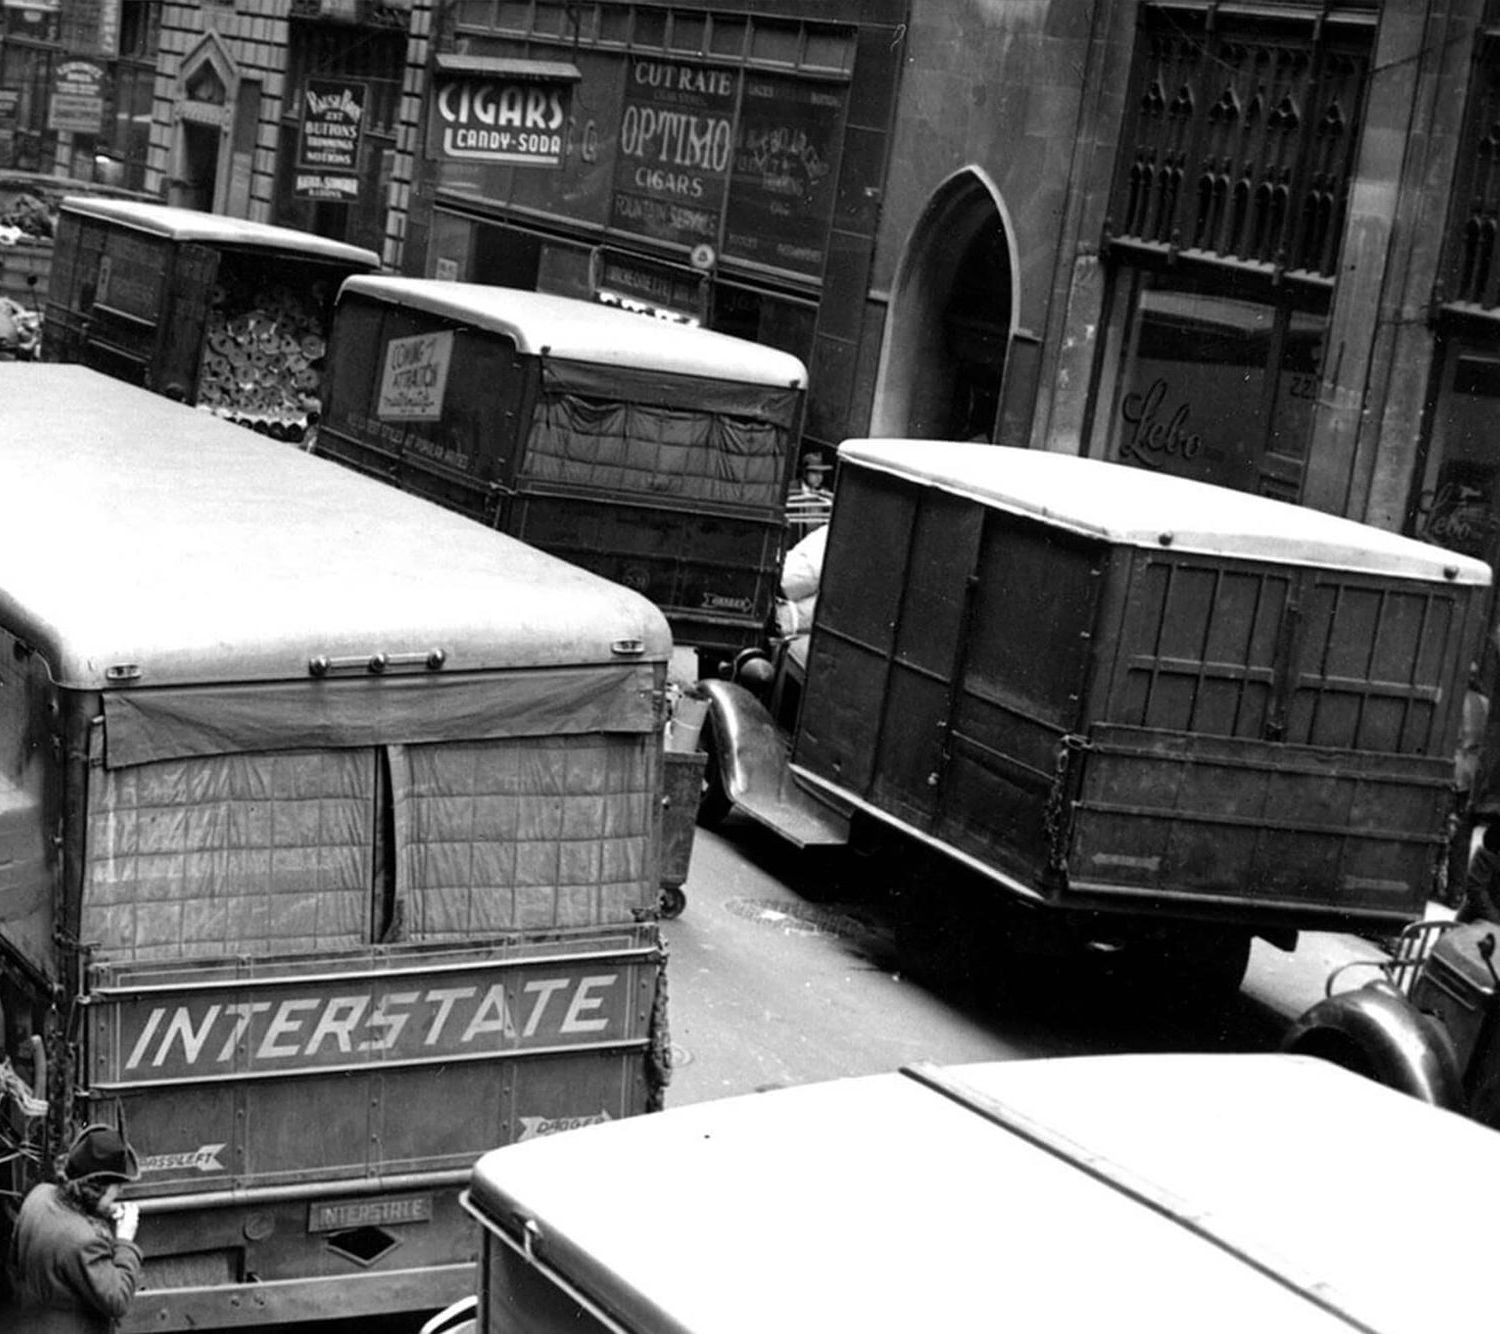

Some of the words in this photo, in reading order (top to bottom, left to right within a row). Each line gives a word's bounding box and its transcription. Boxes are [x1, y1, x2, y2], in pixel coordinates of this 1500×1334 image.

[635, 61, 677, 88] CUT
[679, 66, 731, 95] RATE
[439, 81, 563, 130] CIGARS
[621, 105, 730, 171] OPTIMO
[635, 166, 703, 197] CIGARS
[1119, 378, 1200, 468] Lebo
[124, 974, 618, 1069] INTERSTATE
[319, 1199, 422, 1226] INTERSTATE
